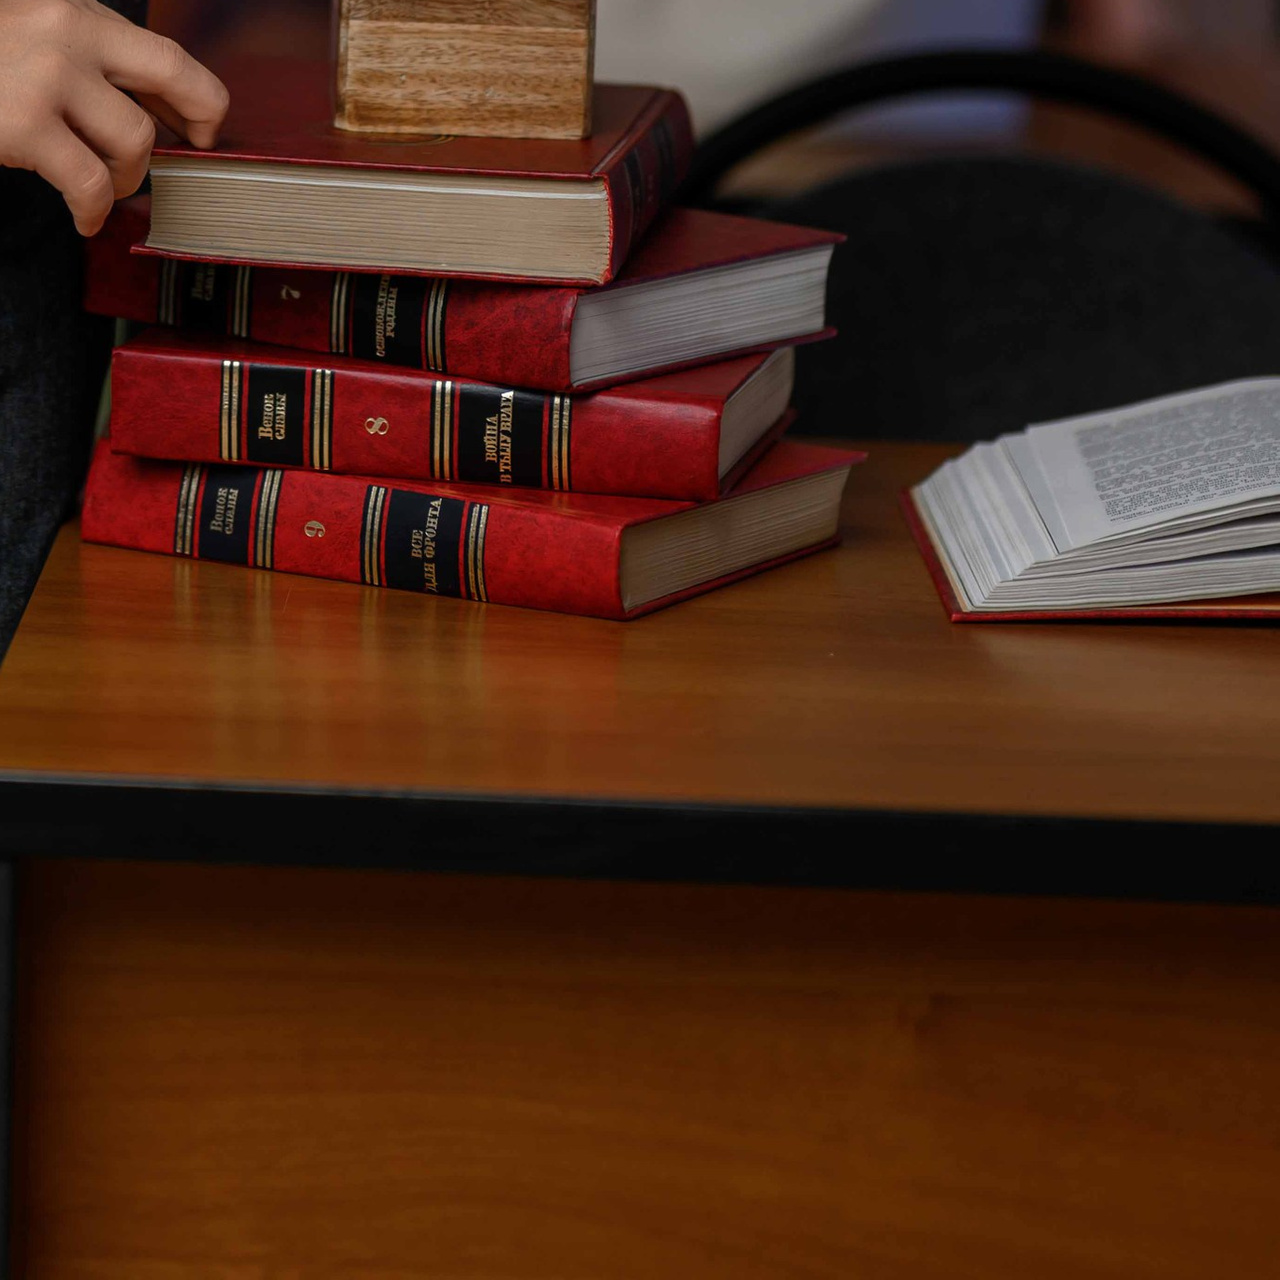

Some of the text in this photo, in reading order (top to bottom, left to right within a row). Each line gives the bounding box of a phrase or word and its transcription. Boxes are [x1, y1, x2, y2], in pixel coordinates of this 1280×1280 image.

[280, 284, 301, 300] 7
[386, 287, 398, 338] РОДИНЫ
[258, 393, 275, 440] Венок
[275, 392, 287, 440] славы
[364, 417, 389, 435] 8
[484, 413, 499, 463] ВОЙНА
[499, 390, 514, 484] В ТЫЛУ ВРАГА
[210, 487, 229, 532] Венок
[225, 488, 239, 535] славы
[411, 529, 424, 558] ВСЕ
[424, 498, 442, 593] ДЛЯ ФРОНТА
